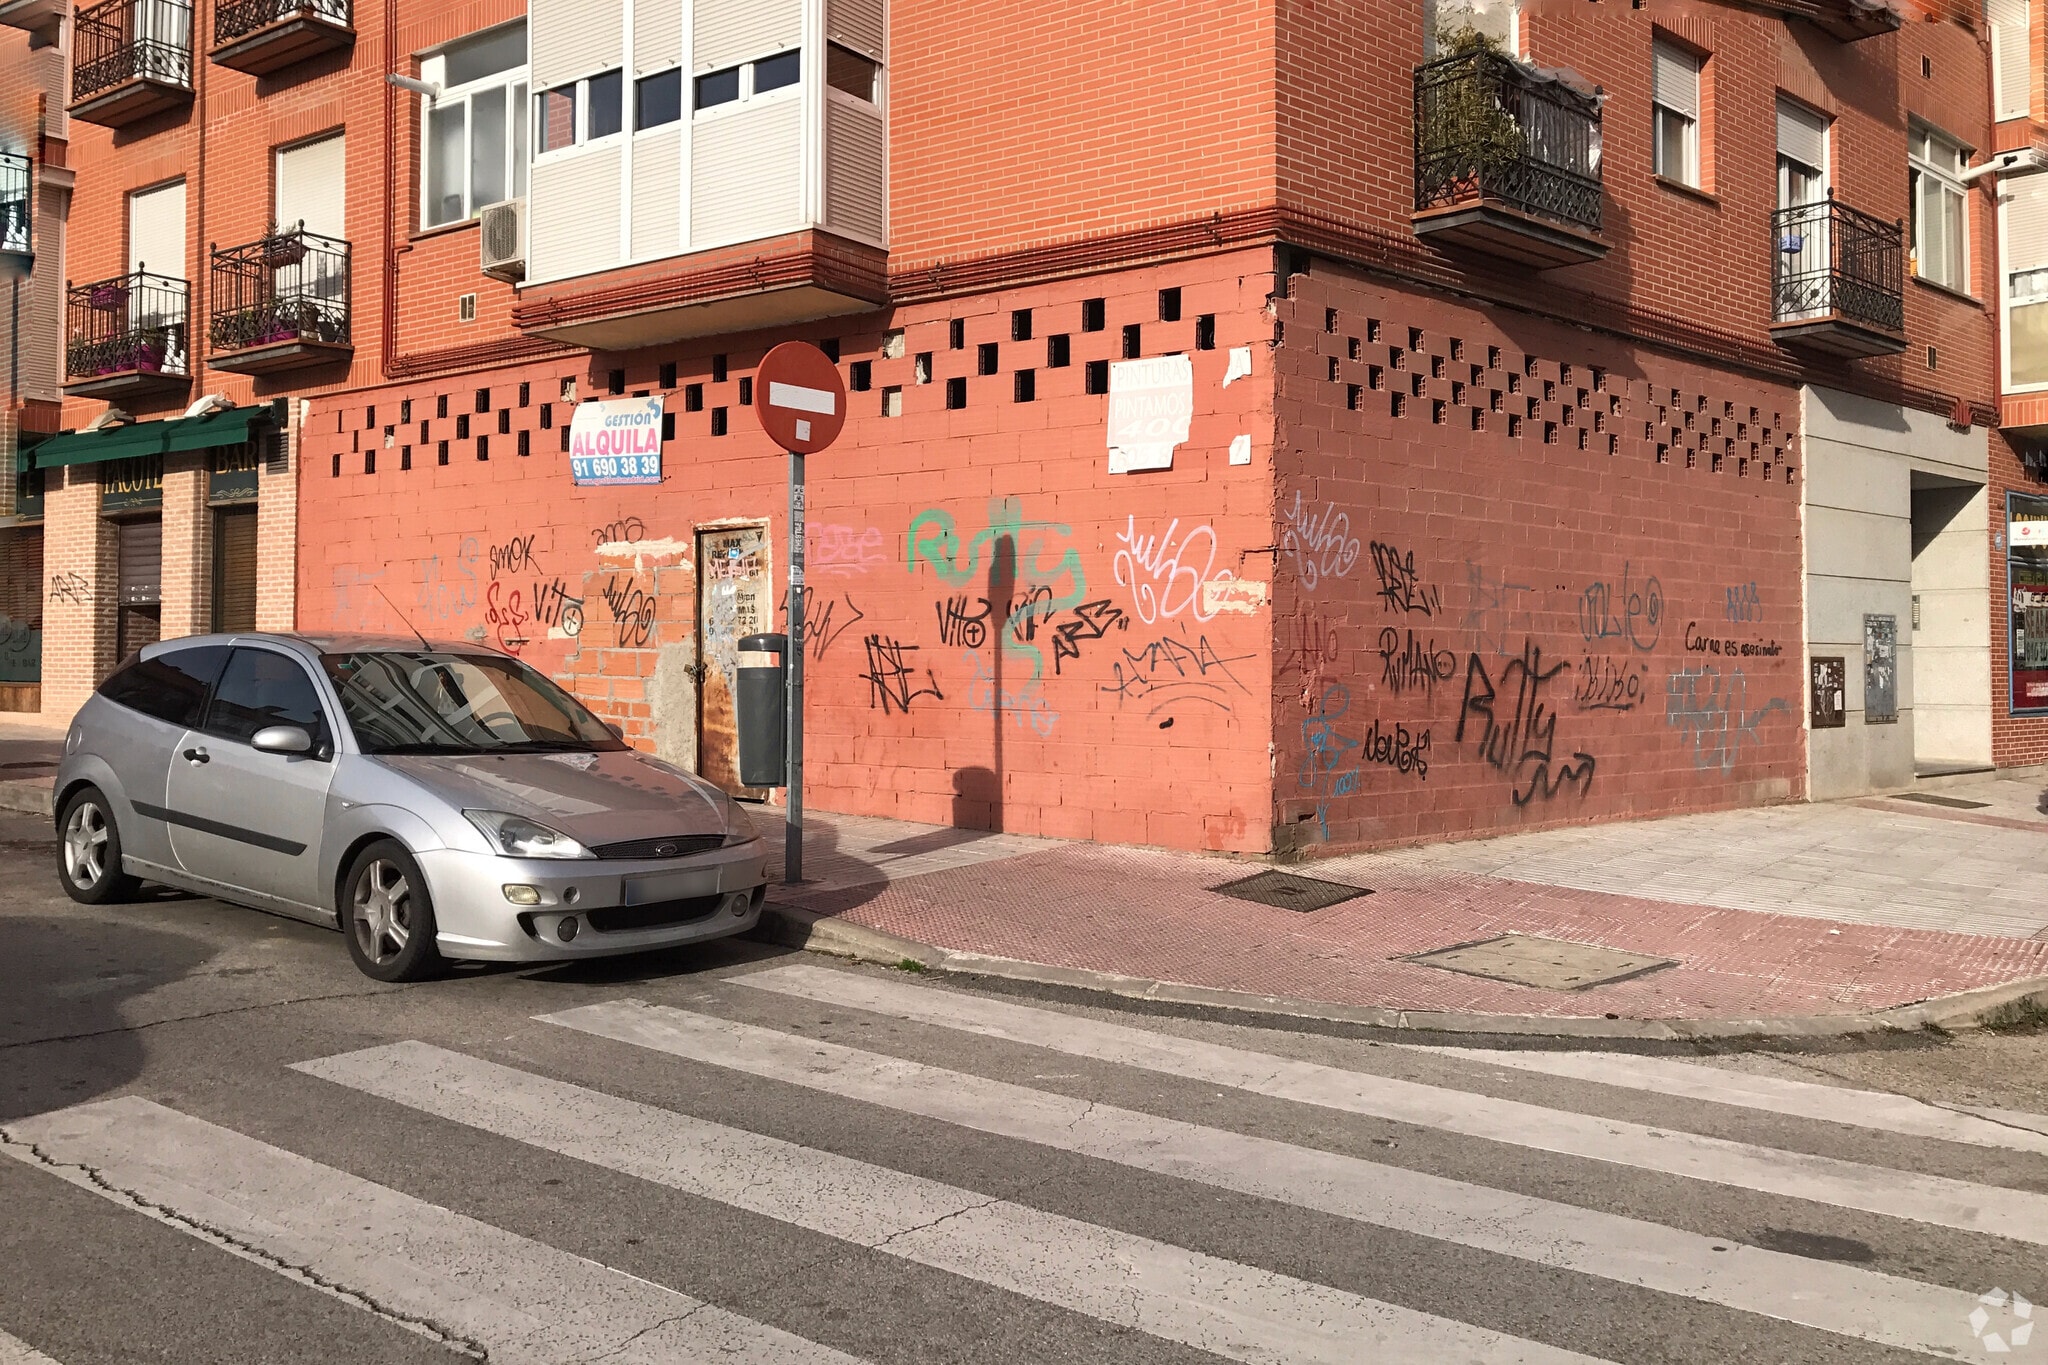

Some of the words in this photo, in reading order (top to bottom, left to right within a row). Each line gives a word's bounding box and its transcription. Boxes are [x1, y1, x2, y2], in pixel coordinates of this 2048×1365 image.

[605, 410, 652, 427] GESTIÓN
[572, 427, 659, 457] ALQUILA
[572, 459, 589, 477] 91
[592, 458, 617, 476] 690
[620, 457, 638, 475] 38
[641, 455, 658, 475] 39
